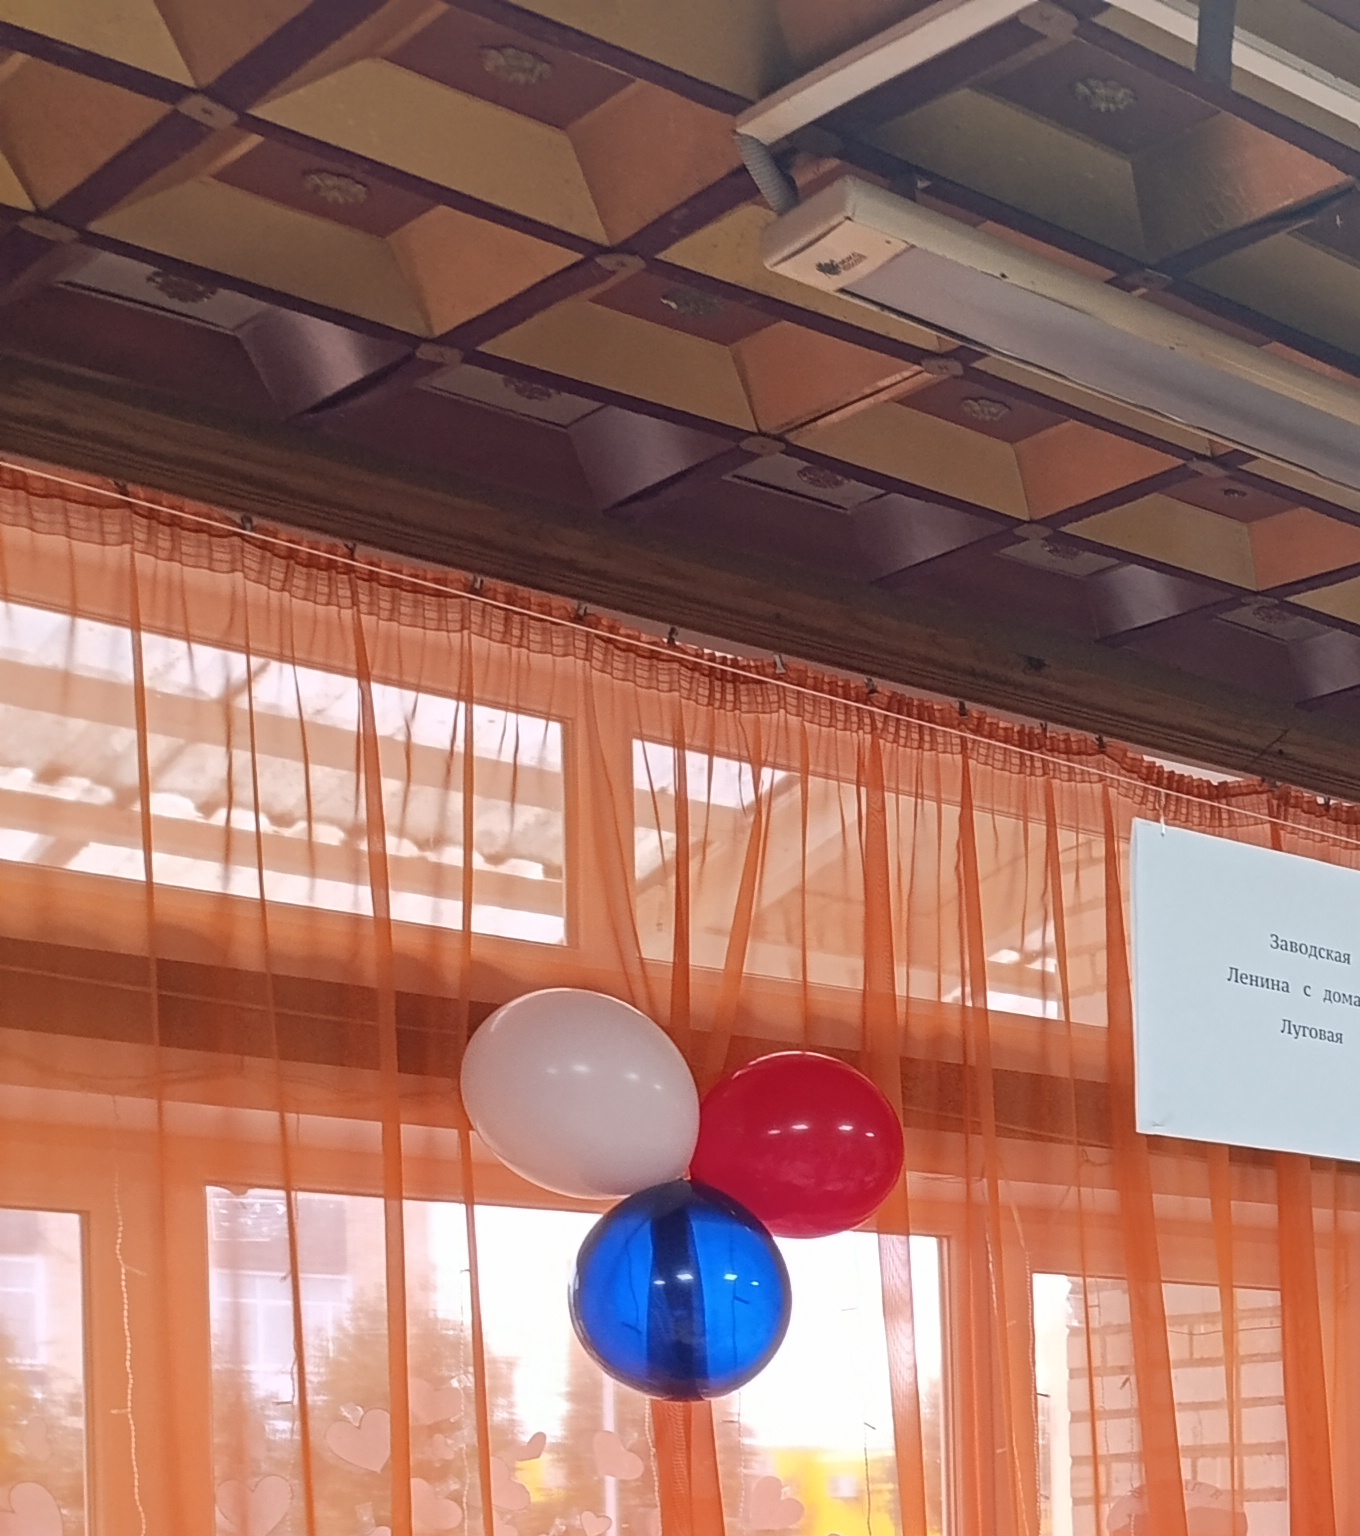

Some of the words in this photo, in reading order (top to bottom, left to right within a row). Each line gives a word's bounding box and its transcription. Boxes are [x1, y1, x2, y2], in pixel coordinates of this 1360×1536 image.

[1269, 933, 1352, 966] Заводская
[1226, 966, 1291, 994] Ленина
[1303, 983, 1312, 997] с
[1281, 1018, 1344, 1045] Луговая
